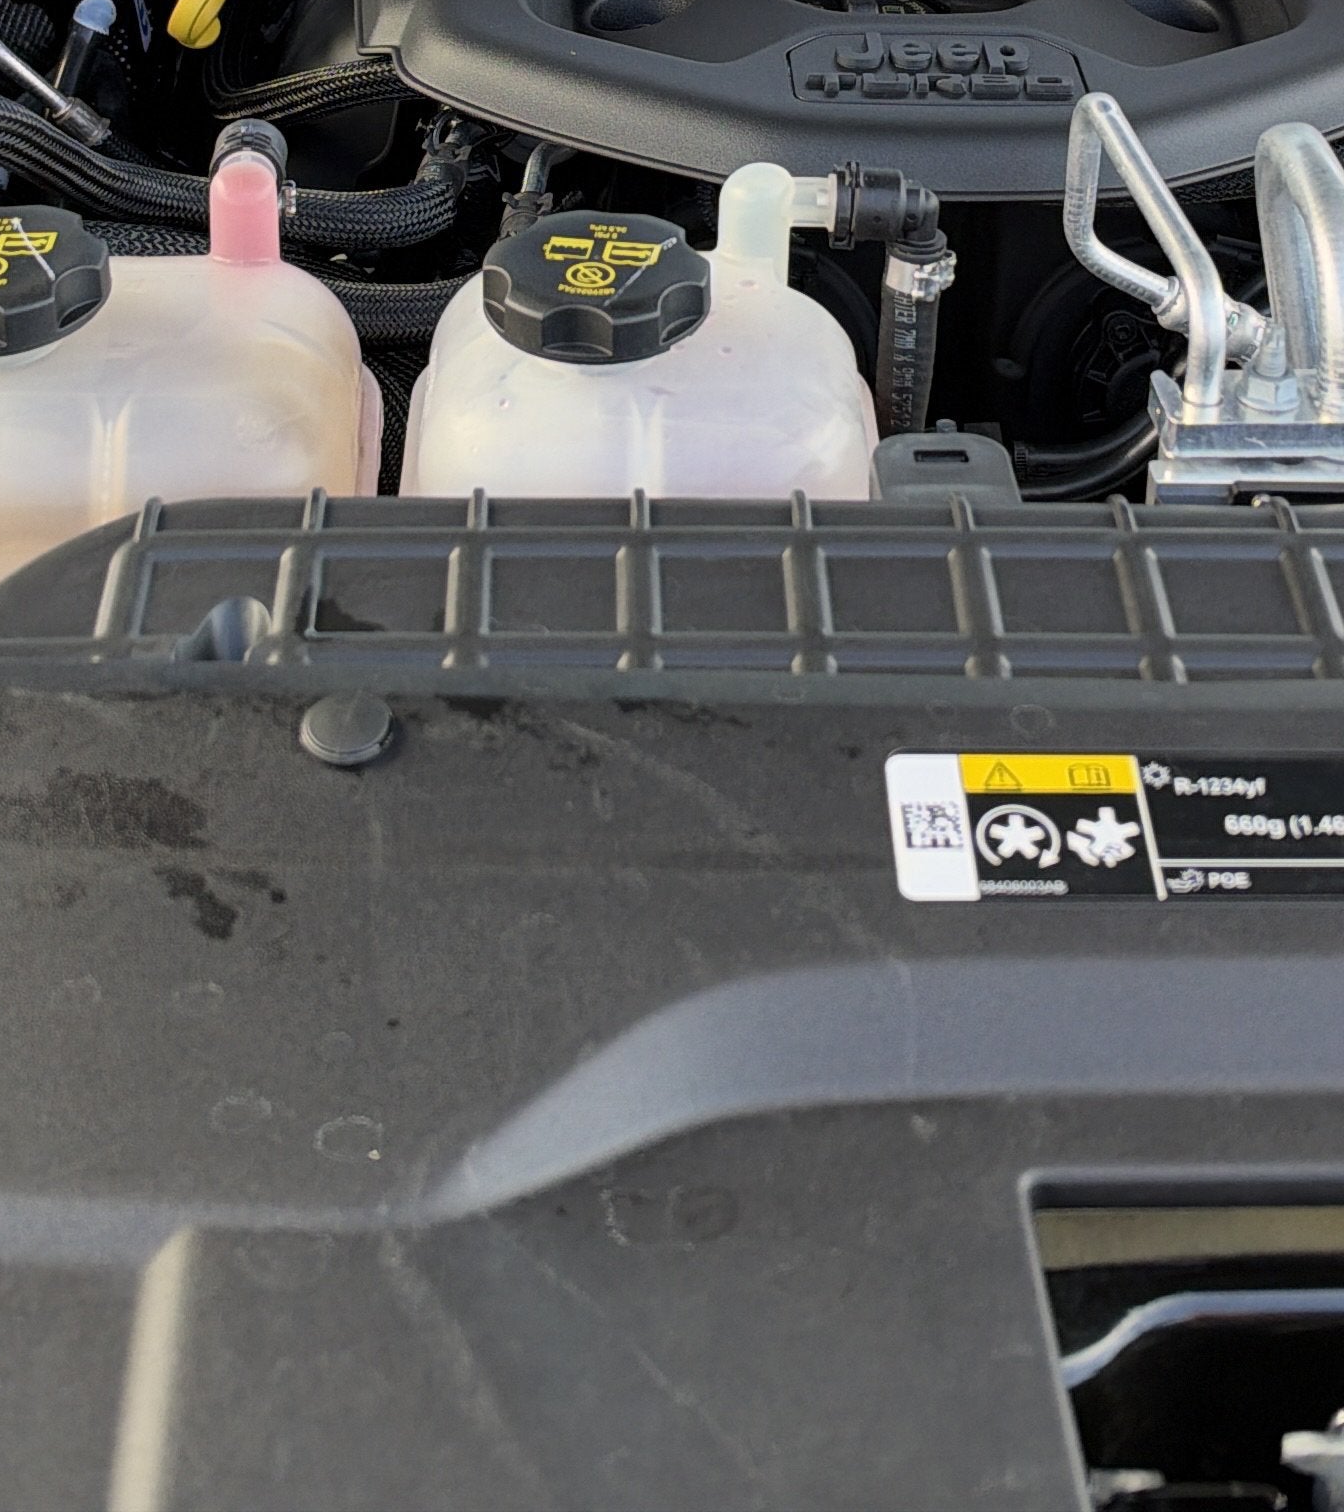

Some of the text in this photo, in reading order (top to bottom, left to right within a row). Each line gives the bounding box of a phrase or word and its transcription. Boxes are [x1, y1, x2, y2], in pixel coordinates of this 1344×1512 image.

[835, 33, 1030, 73] Jeep
[806, 72, 1074, 100] TURBO
[1208, 871, 1252, 889] POE
